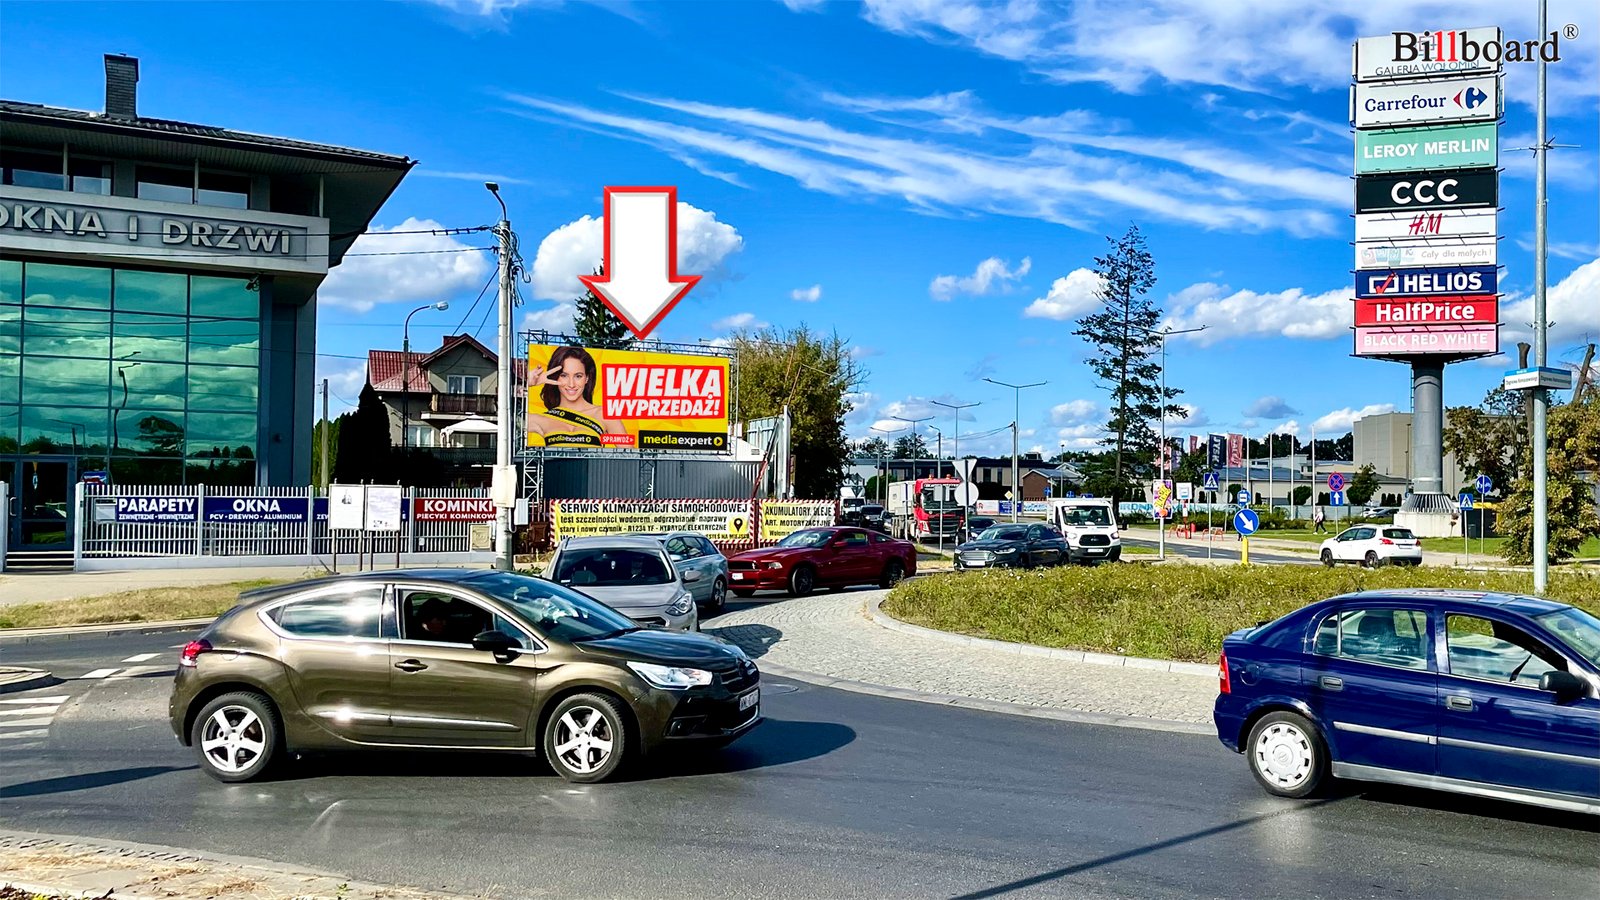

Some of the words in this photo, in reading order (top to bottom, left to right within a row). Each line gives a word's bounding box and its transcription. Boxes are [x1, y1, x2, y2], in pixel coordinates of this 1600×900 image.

[1375, 64, 1420, 76] GALERIA
[1364, 95, 1447, 113] Carrefour
[1363, 143, 1419, 159] LEROY
[1424, 138, 1490, 155] MERLIN
[1391, 179, 1459, 204] CCC
[1408, 213, 1443, 236] H&M
[128, 216, 139, 241] I
[162, 219, 291, 254] DRZWI
[1442, 250, 1456, 258] dla
[1403, 272, 1483, 292] HELIOS
[1376, 302, 1475, 321] HalfPrice
[1363, 335, 1406, 346] BLACK
[1411, 334, 1438, 344] RED
[1443, 333, 1488, 344] WHITE
[607, 395, 720, 416] WYPRZEDAŻ!
[643, 434, 713, 446] mediaexpert
[1212, 436, 1220, 463] JYSK
[118, 498, 195, 512] PARAPETY
[233, 499, 281, 512] OKNA
[424, 500, 493, 512] KOMINKI
[560, 503, 600, 513] SERWIS
[602, 503, 669, 514] KLIMATYZACJI
[671, 503, 748, 513] SAMOCHODOWEJ
[560, 515, 574, 523] test
[575, 514, 617, 523] szczelności
